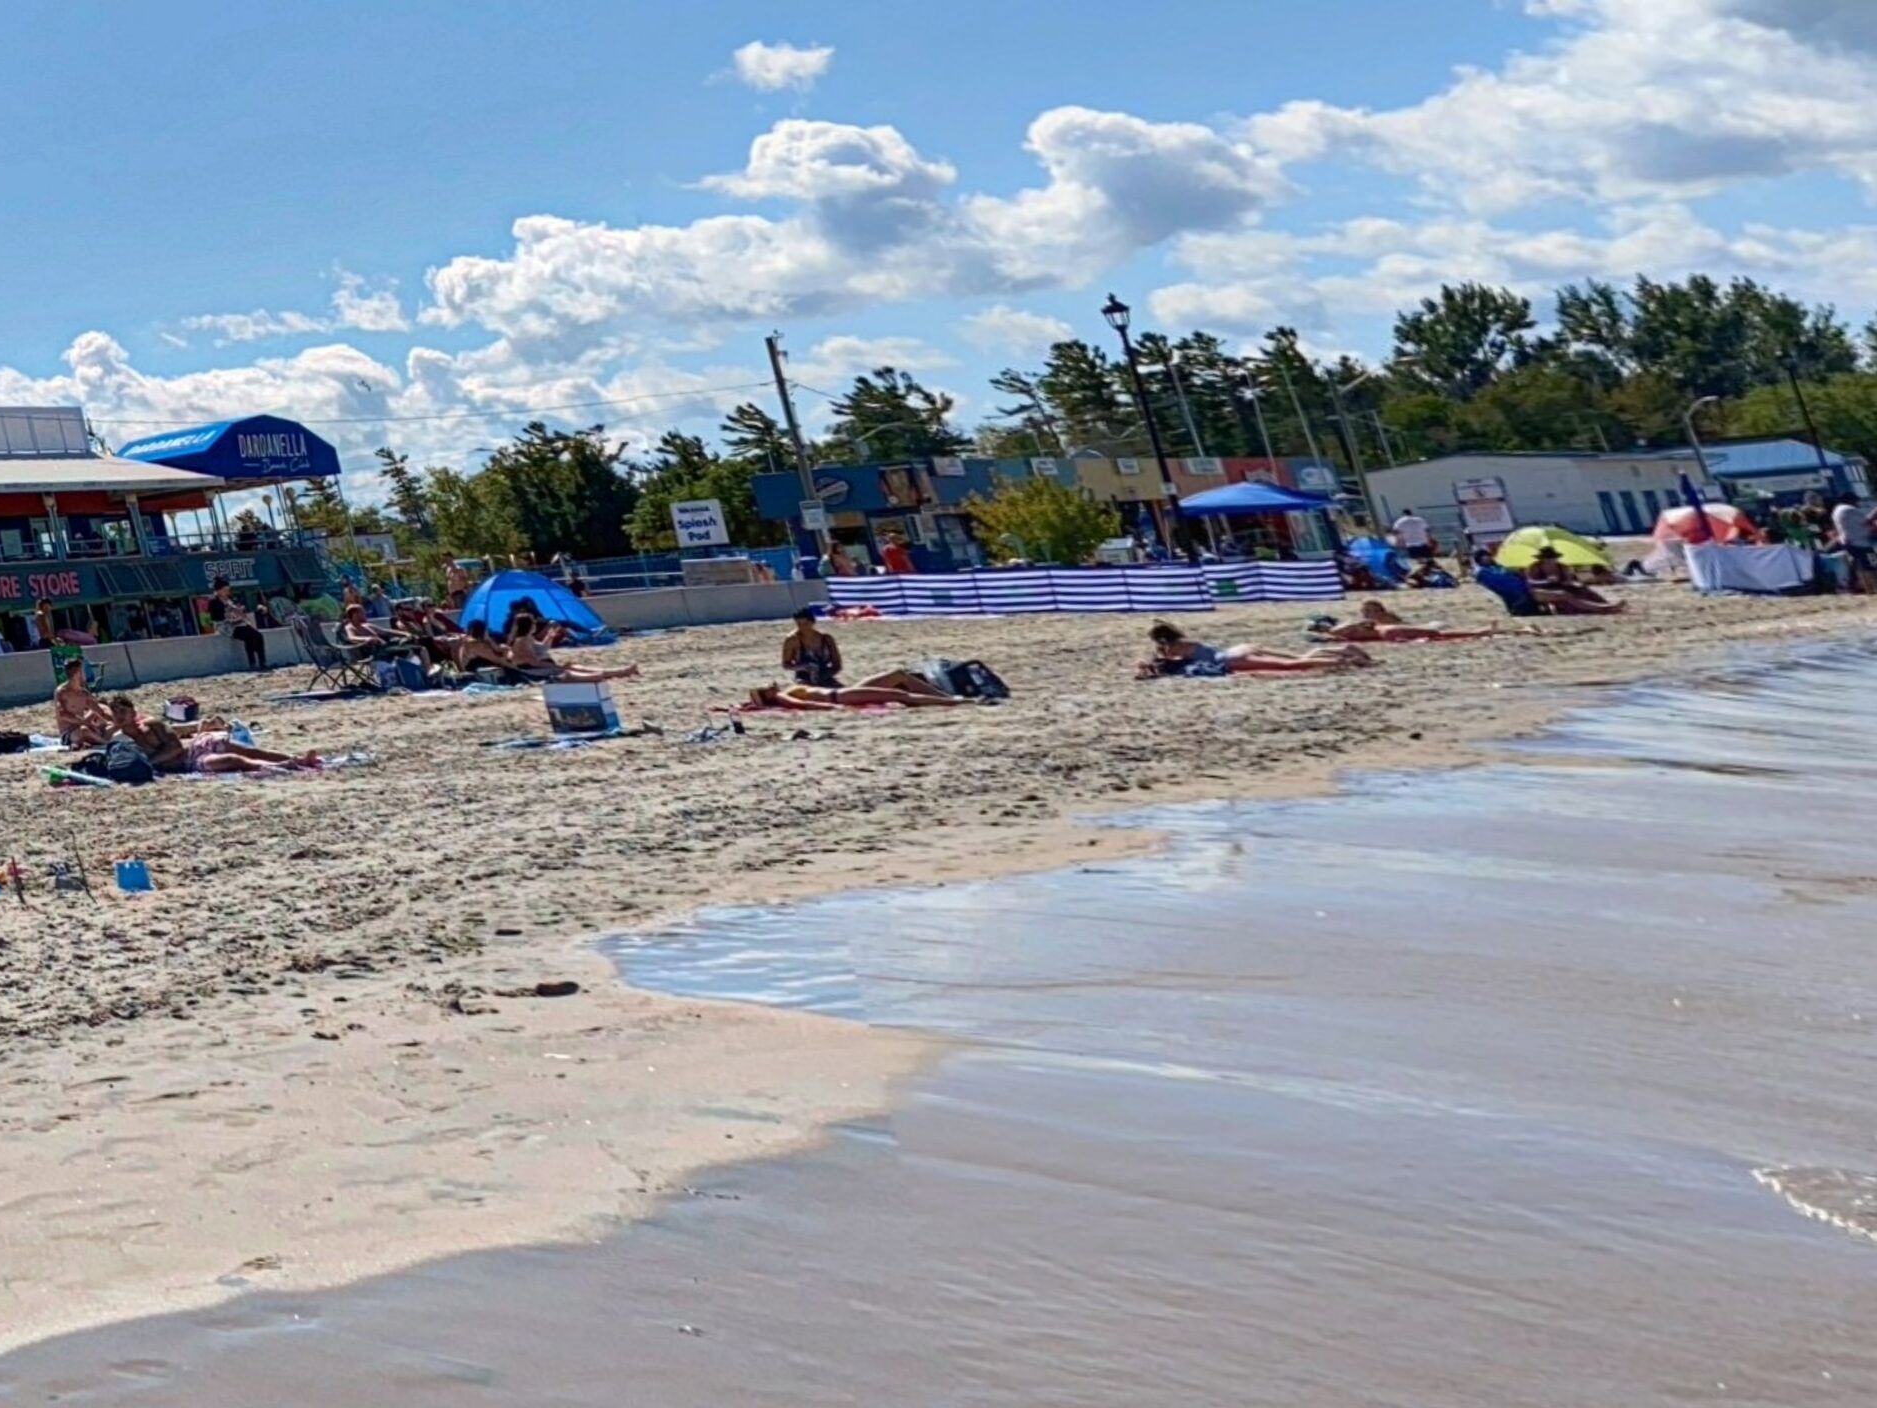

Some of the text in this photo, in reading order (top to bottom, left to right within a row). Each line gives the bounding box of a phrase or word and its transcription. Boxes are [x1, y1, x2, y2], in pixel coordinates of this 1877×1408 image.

[238, 433, 308, 458] DARDANELLA
[677, 515, 717, 530] Splash
[28, 571, 80, 596] STORE
